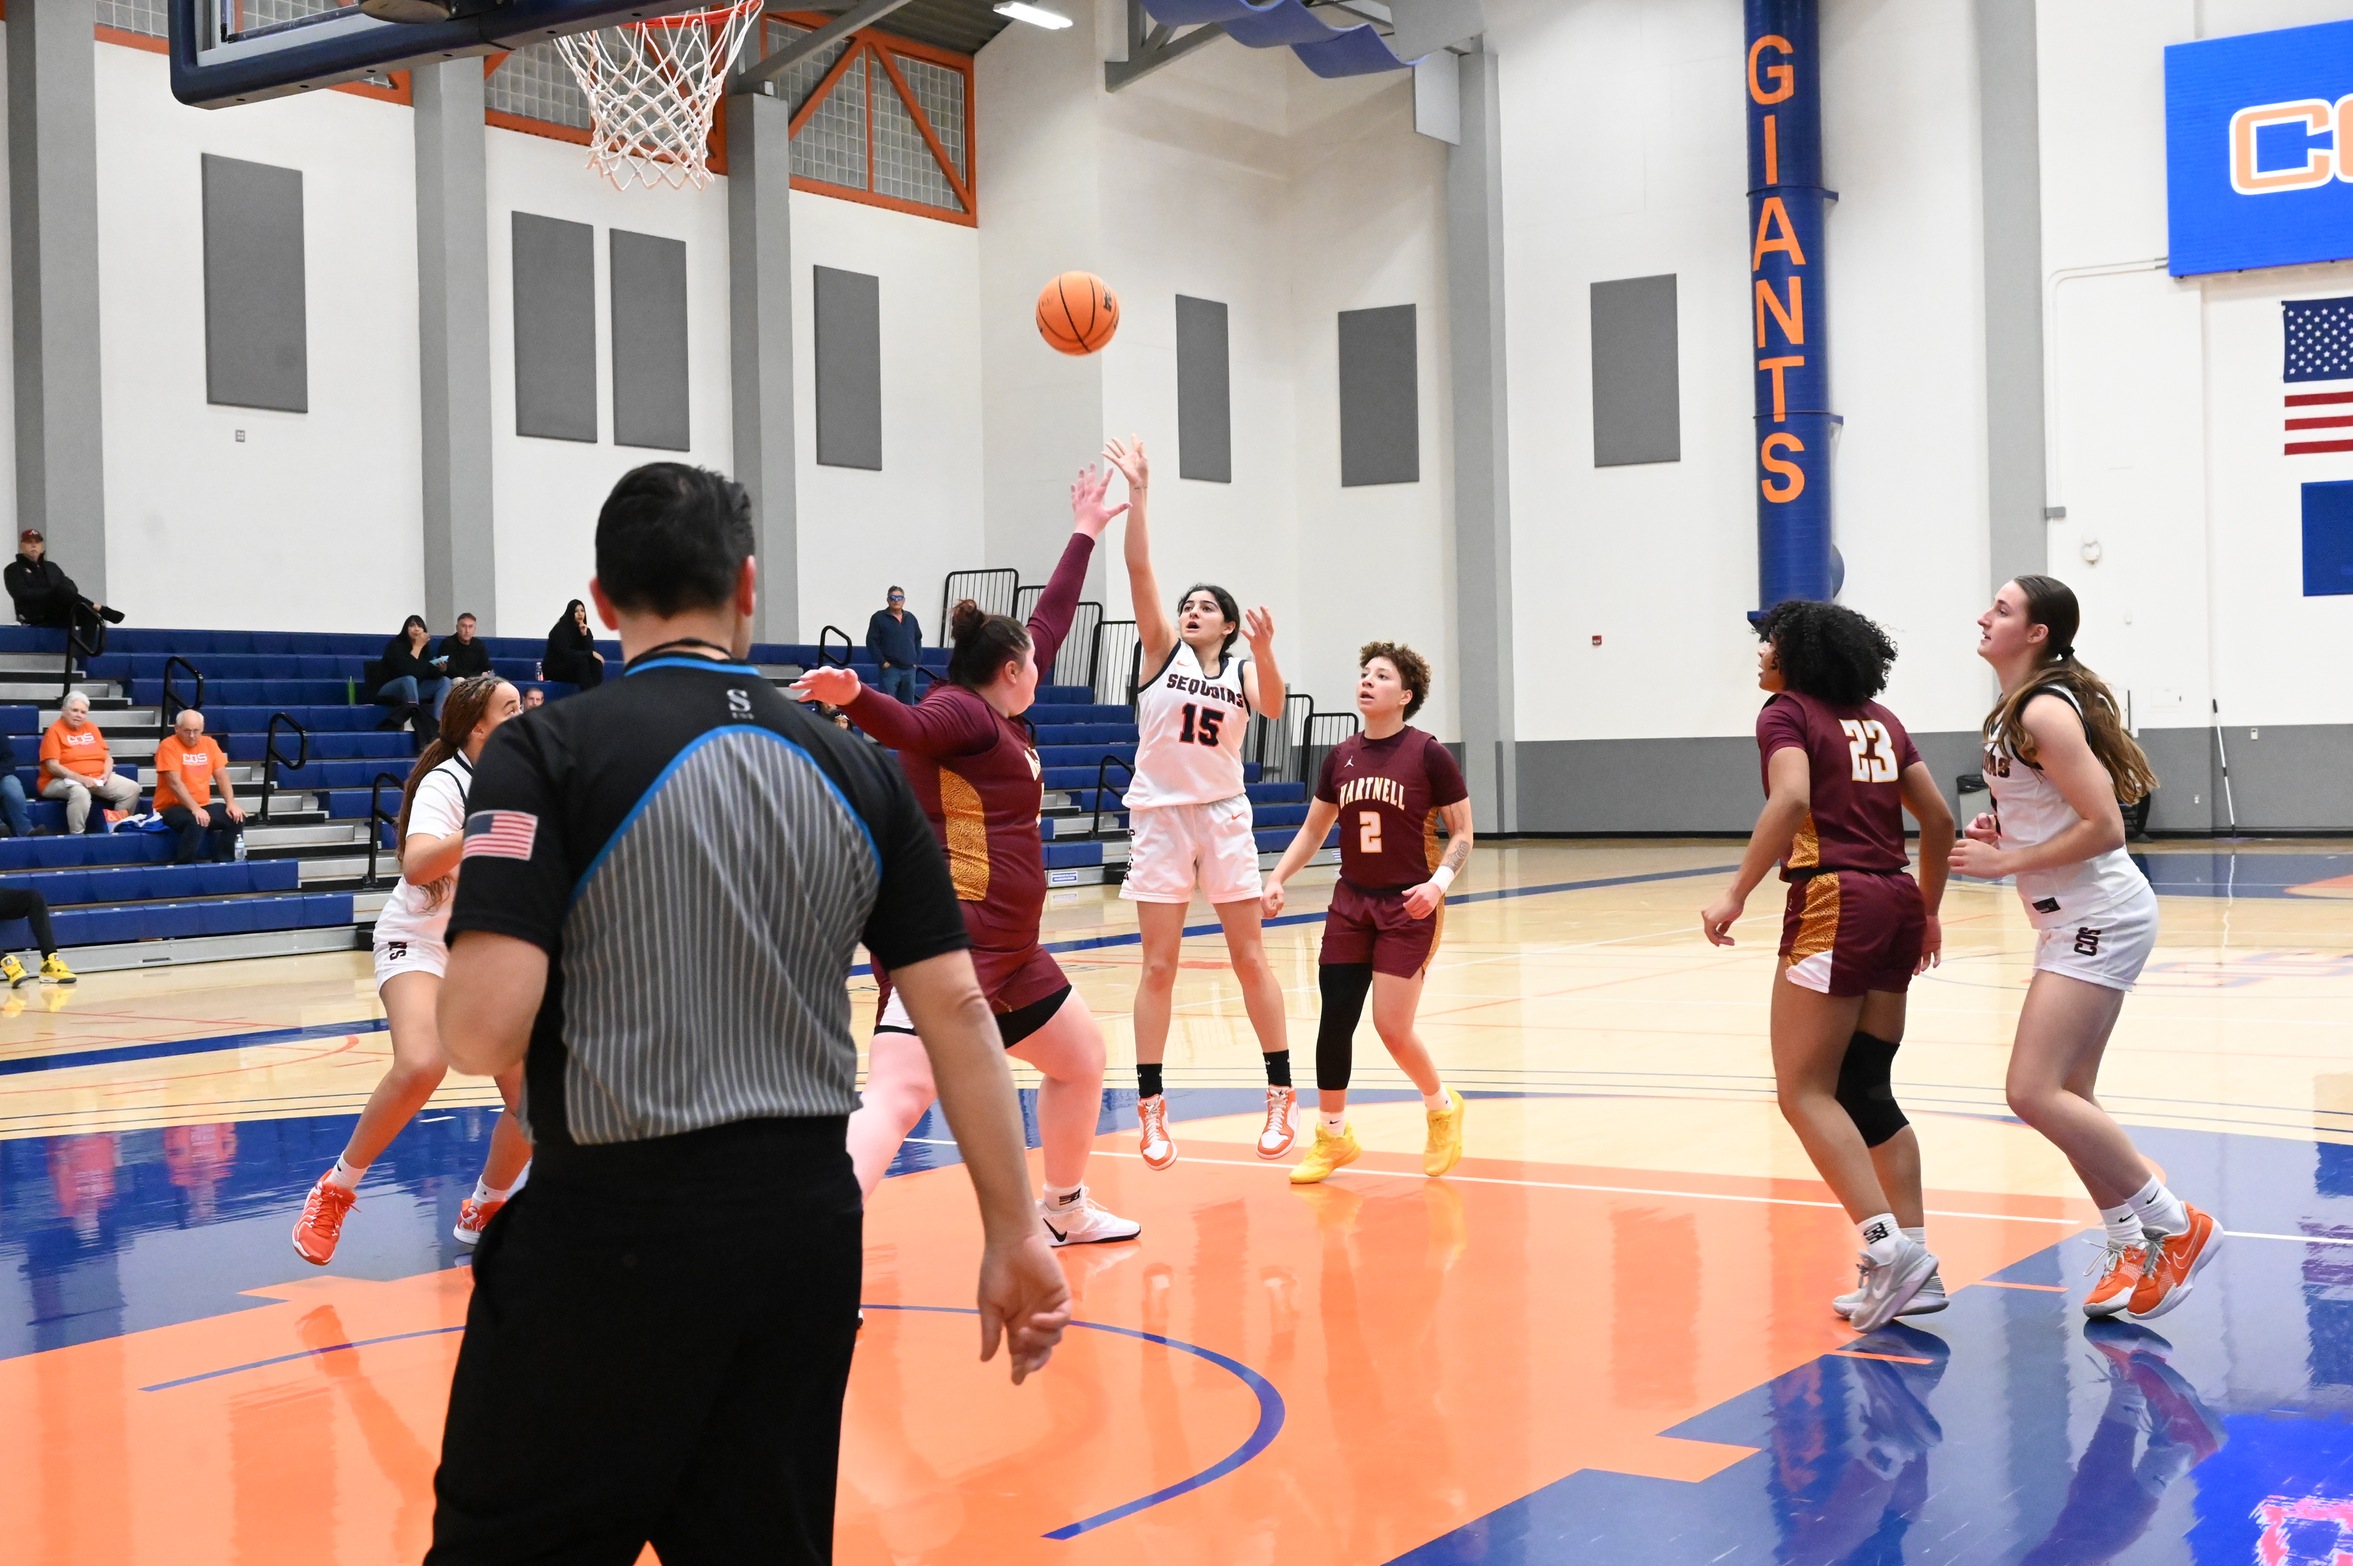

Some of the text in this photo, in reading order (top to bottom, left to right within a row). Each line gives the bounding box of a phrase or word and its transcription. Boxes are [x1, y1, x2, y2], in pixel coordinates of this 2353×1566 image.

[2229, 92, 2353, 196] C
[1747, 34, 1807, 504] GIANTS
[1166, 673, 1244, 708] SEQUOIAS
[1179, 702, 1226, 747] 15
[1838, 718, 1899, 784] 23
[1340, 776, 1406, 811] HARTNELL
[1359, 811, 1383, 853] 2
[2073, 926, 2102, 957] COS
